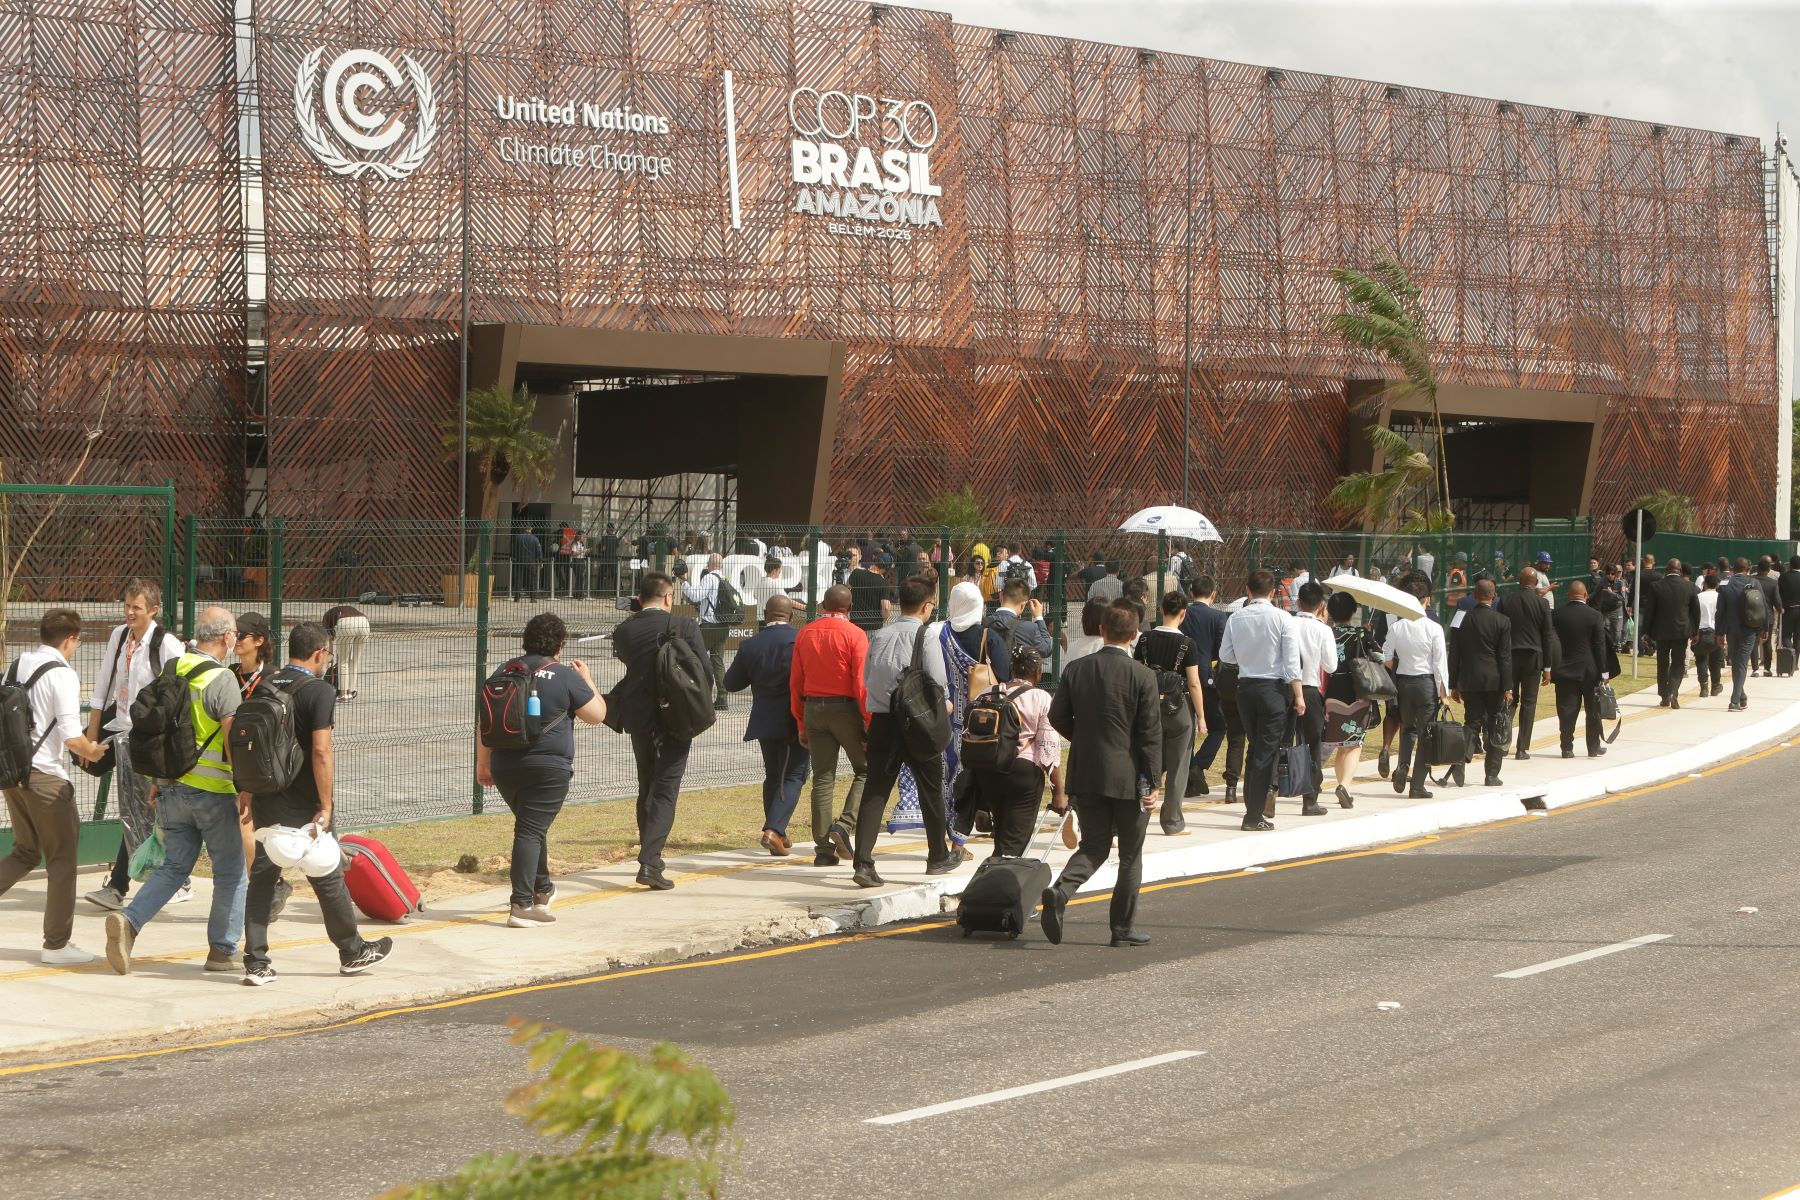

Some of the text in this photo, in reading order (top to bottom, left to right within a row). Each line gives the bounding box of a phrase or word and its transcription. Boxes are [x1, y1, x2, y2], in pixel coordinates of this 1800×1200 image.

[497, 95, 670, 134] United Nations
[500, 136, 672, 180] Climate Change
[792, 139, 942, 196] BRASIL
[794, 188, 943, 227] AMAZÔNIA
[877, 227, 911, 240] 2025
